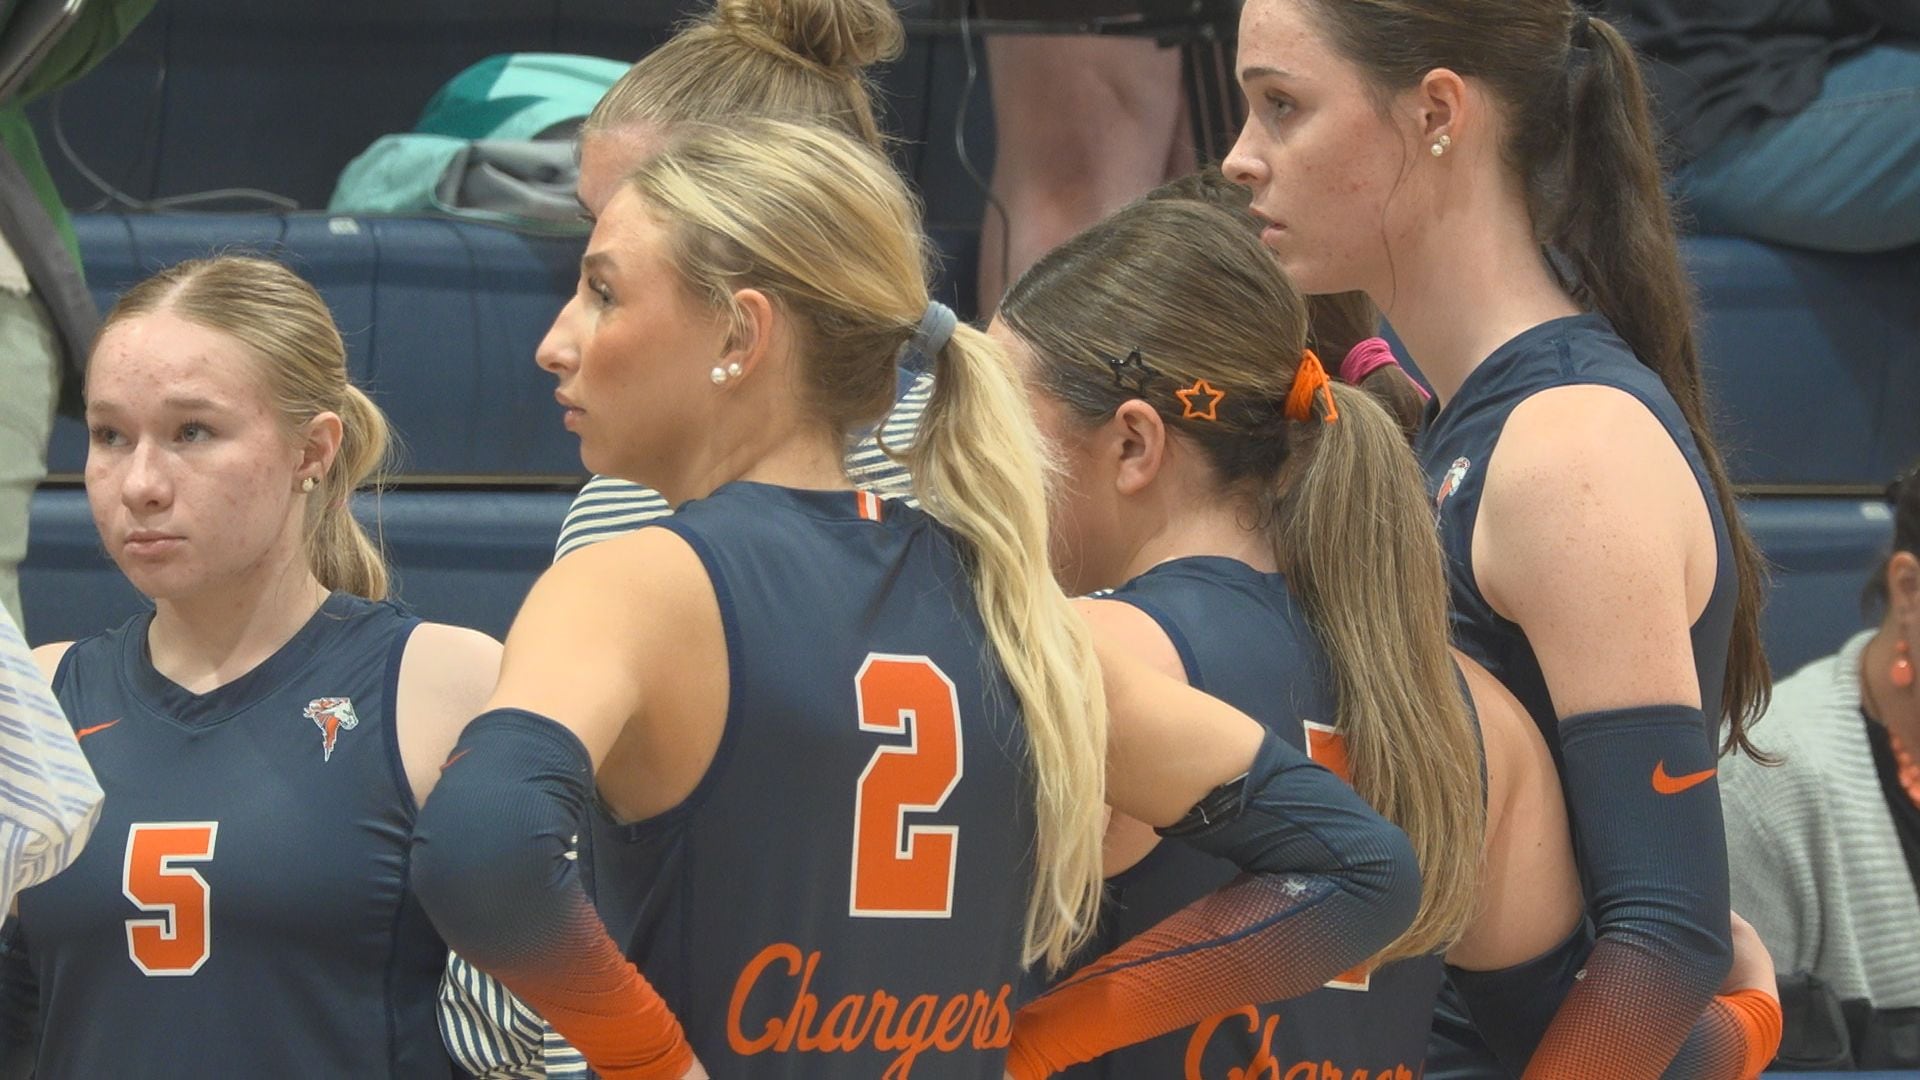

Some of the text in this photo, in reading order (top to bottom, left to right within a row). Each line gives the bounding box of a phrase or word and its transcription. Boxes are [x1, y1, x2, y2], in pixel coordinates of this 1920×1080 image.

[849, 652, 963, 918] 2
[122, 821, 219, 977] 5
[726, 943, 1013, 1080] Chargers
